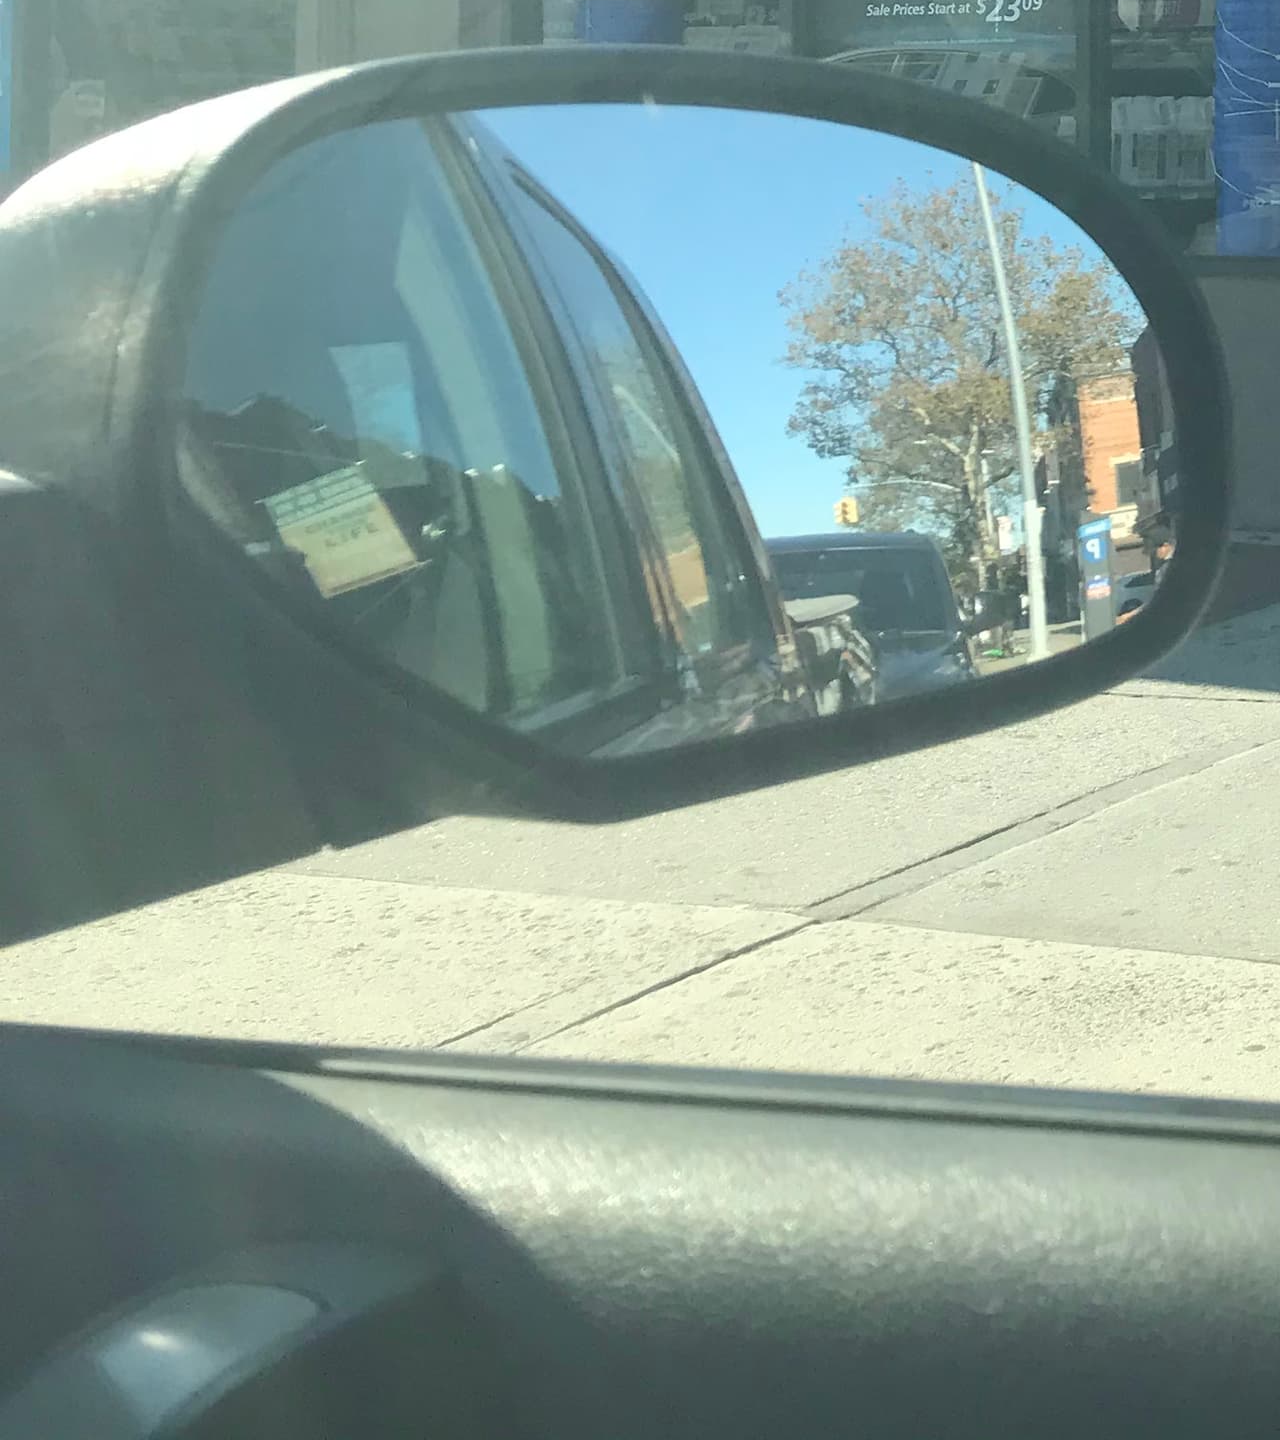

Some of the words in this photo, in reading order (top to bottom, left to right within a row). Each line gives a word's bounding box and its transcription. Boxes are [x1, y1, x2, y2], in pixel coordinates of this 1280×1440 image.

[866, 3, 891, 17] Sale
[892, 2, 925, 16] Prices
[927, 2, 956, 15] Start
[958, 2, 972, 14] at
